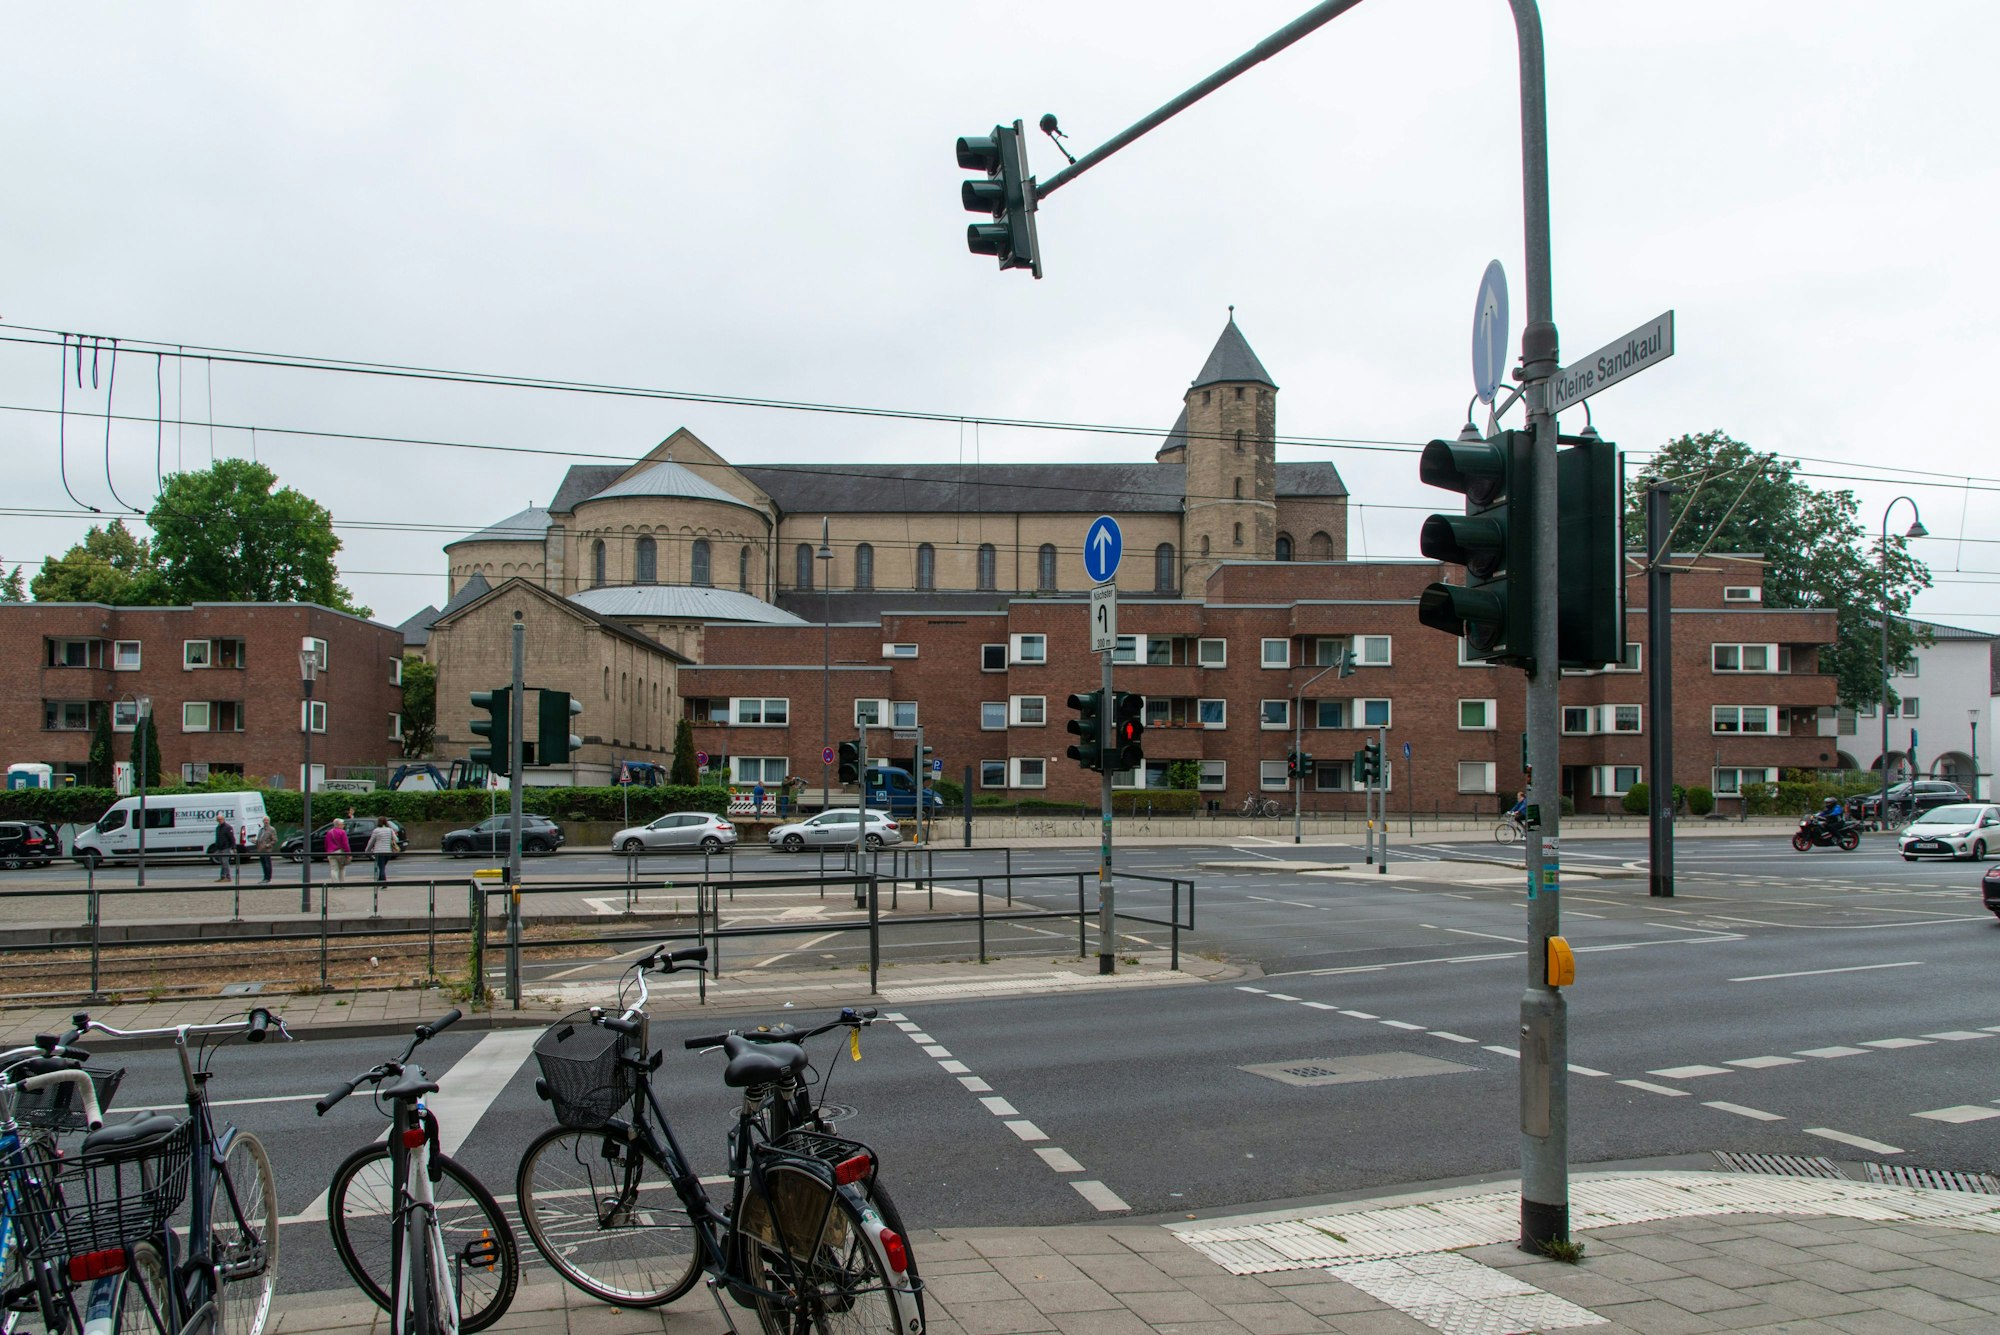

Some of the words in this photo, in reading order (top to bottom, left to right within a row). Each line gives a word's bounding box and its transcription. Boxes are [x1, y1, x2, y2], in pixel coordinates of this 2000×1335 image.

[1556, 370, 1594, 405] Kleine
[1597, 325, 1662, 382] Sandkaul
[1093, 588, 1114, 601] Nächster
[1097, 638, 1105, 648] 300
[197, 809, 235, 819] KOCH
